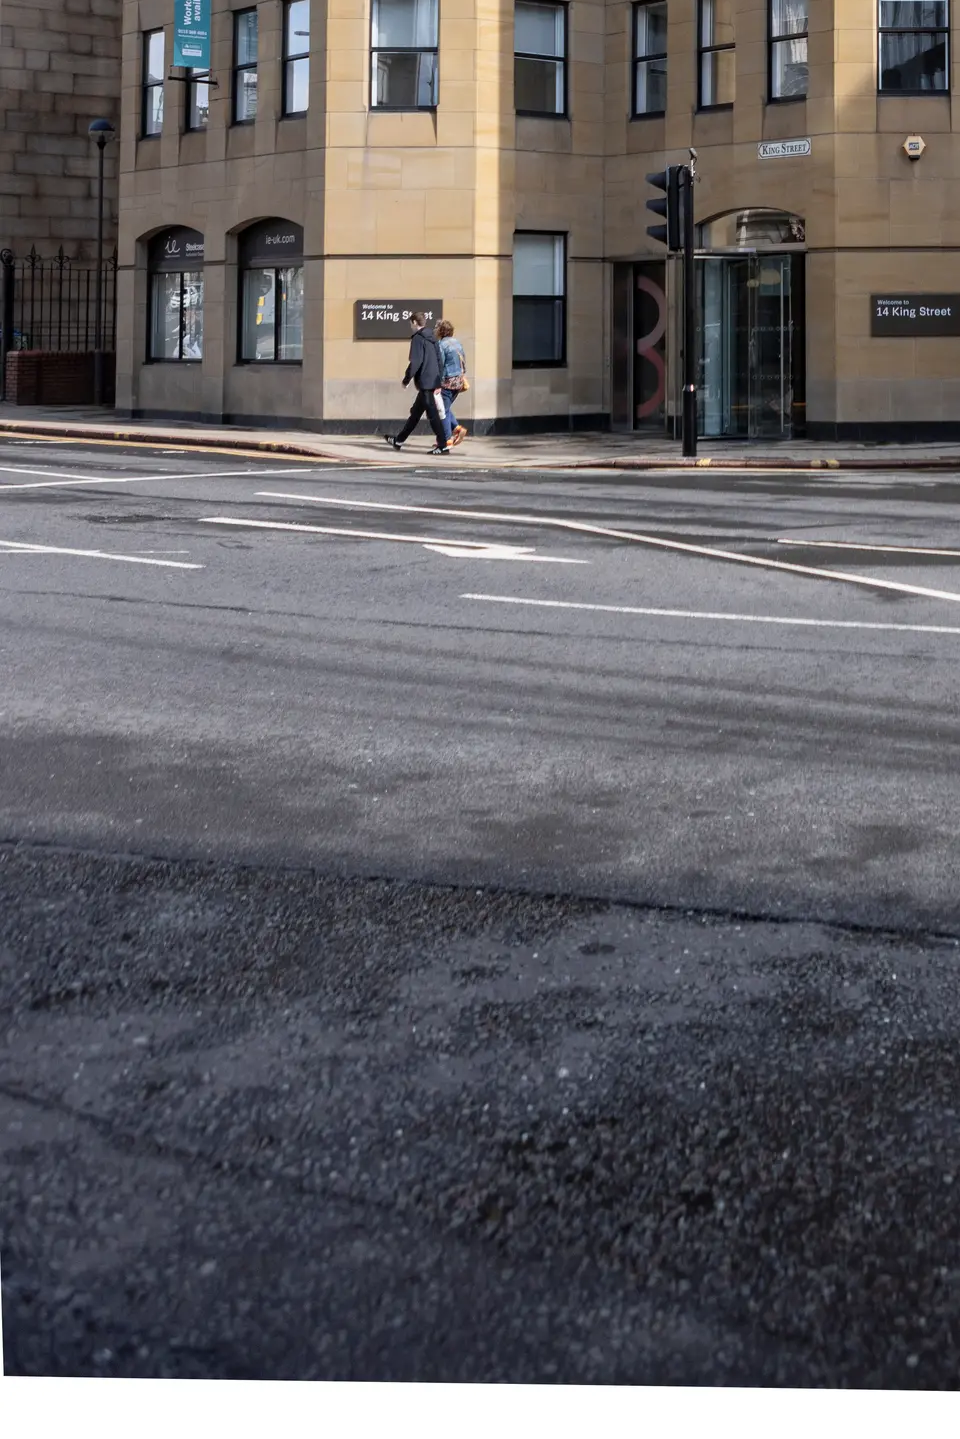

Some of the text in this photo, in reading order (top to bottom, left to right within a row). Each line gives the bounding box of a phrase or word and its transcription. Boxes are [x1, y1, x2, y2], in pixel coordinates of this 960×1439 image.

[762, 143, 806, 155] KING STREET
[265, 233, 295, 245] ie-uk.com
[361, 310, 433, 322] 14 King Stet
[876, 306, 951, 319] 14 King Street
